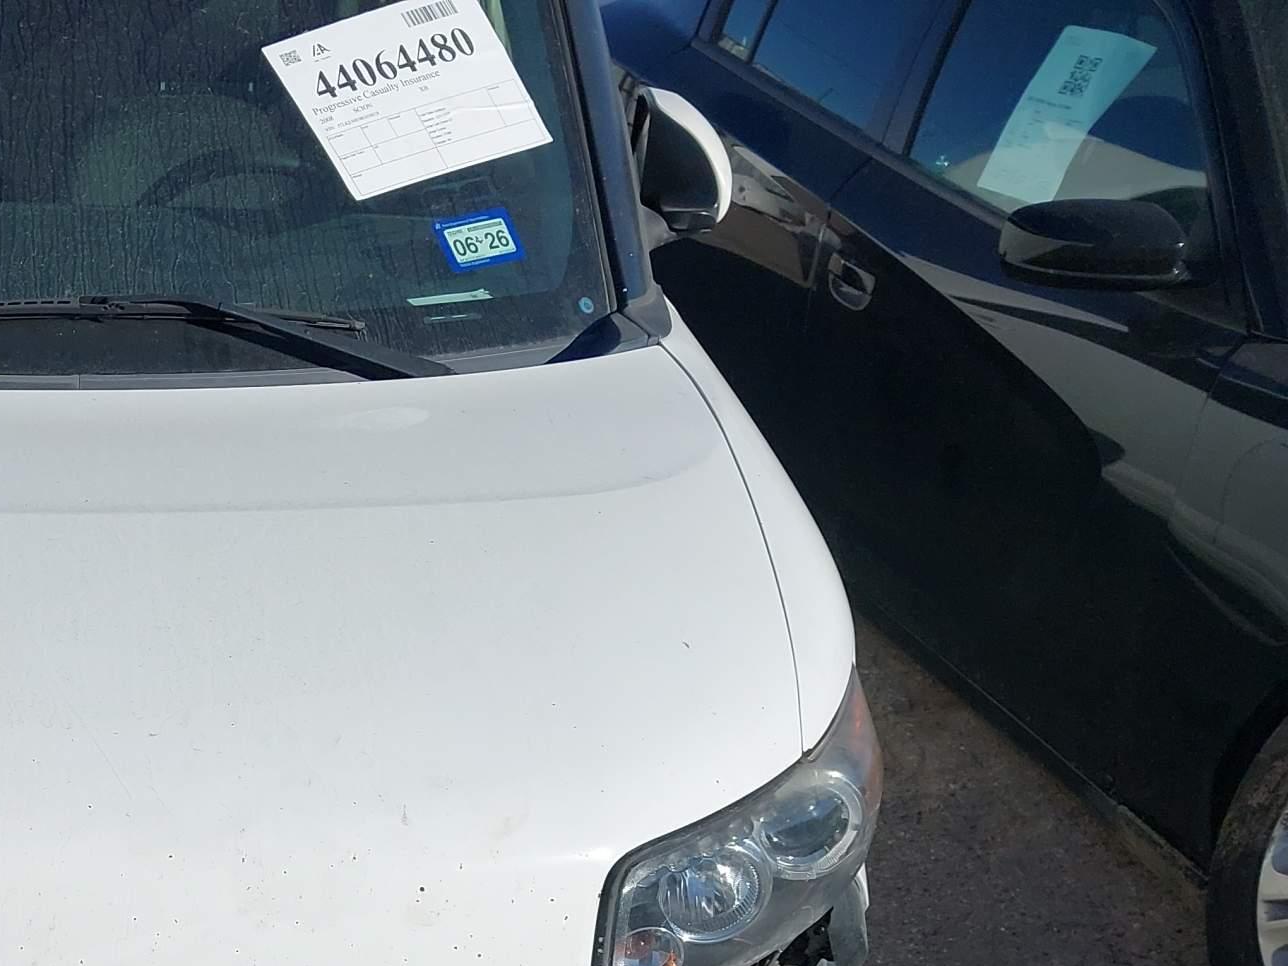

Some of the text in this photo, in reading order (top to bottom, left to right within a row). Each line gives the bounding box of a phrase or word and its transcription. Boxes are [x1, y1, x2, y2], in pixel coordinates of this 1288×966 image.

[316, 27, 475, 99] 44064480
[312, 69, 441, 116] Progressive Casualty Insurance
[453, 229, 510, 257] 06 26
